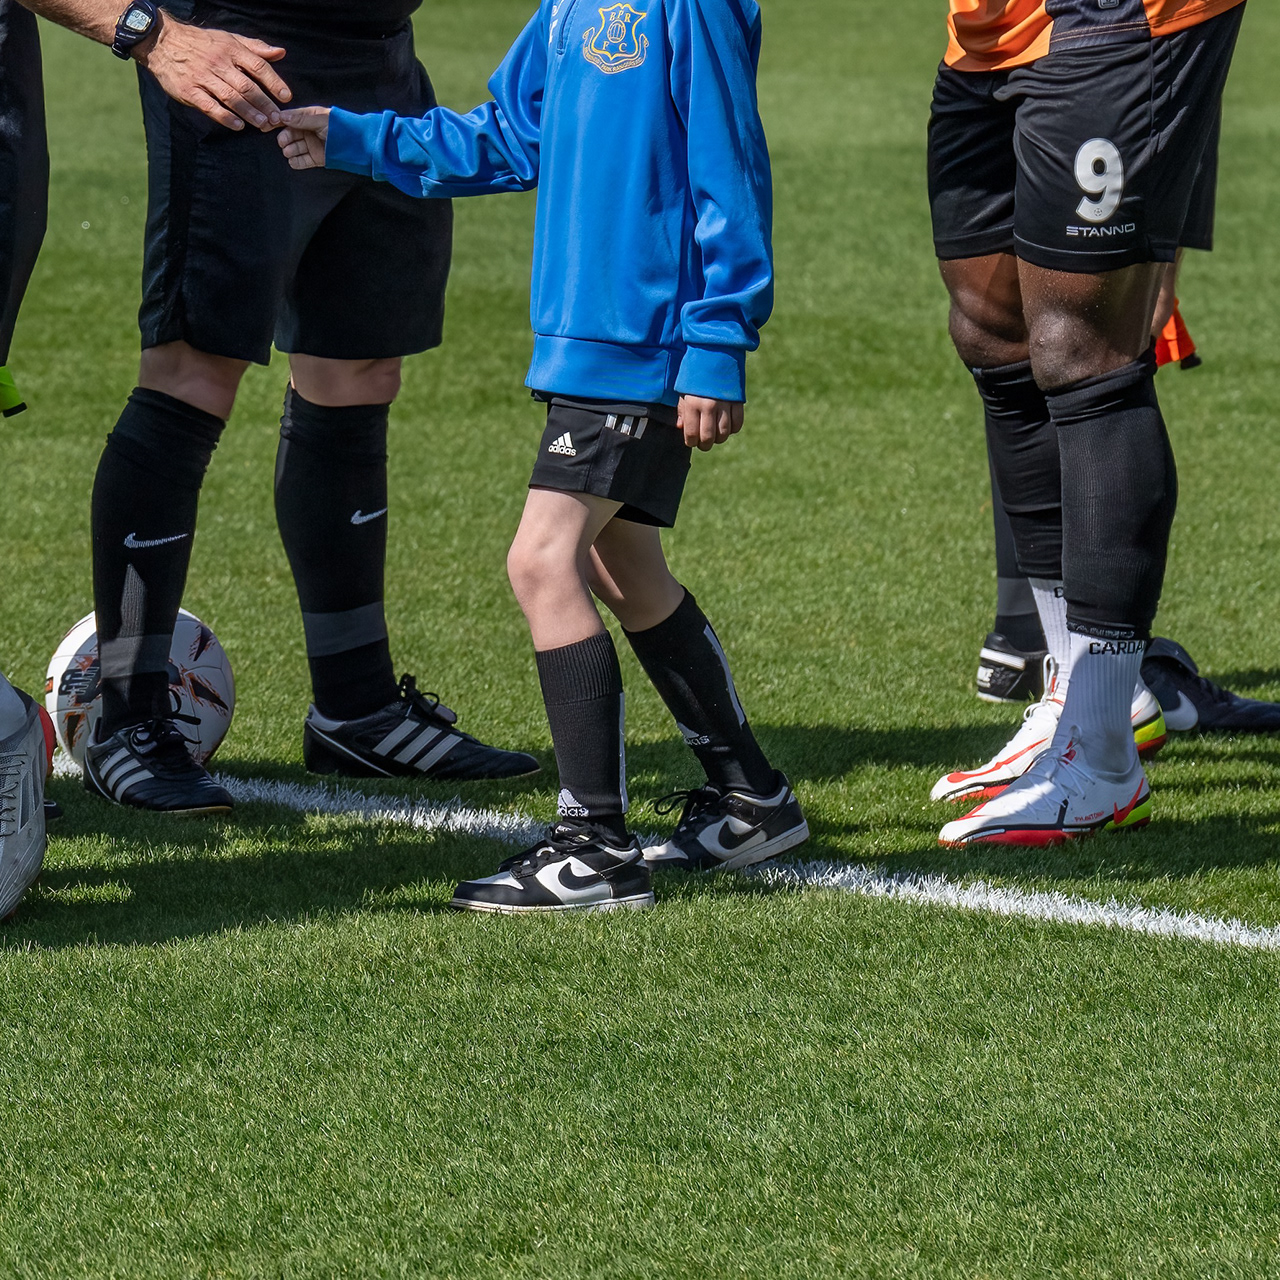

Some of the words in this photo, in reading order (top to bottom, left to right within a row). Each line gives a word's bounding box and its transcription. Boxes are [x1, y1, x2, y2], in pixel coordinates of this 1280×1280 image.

[1074, 137, 1125, 223] 9
[1066, 222, 1136, 238] STANNO
[548, 444, 577, 457] adidas
[1089, 641, 1144, 656] CARDA
